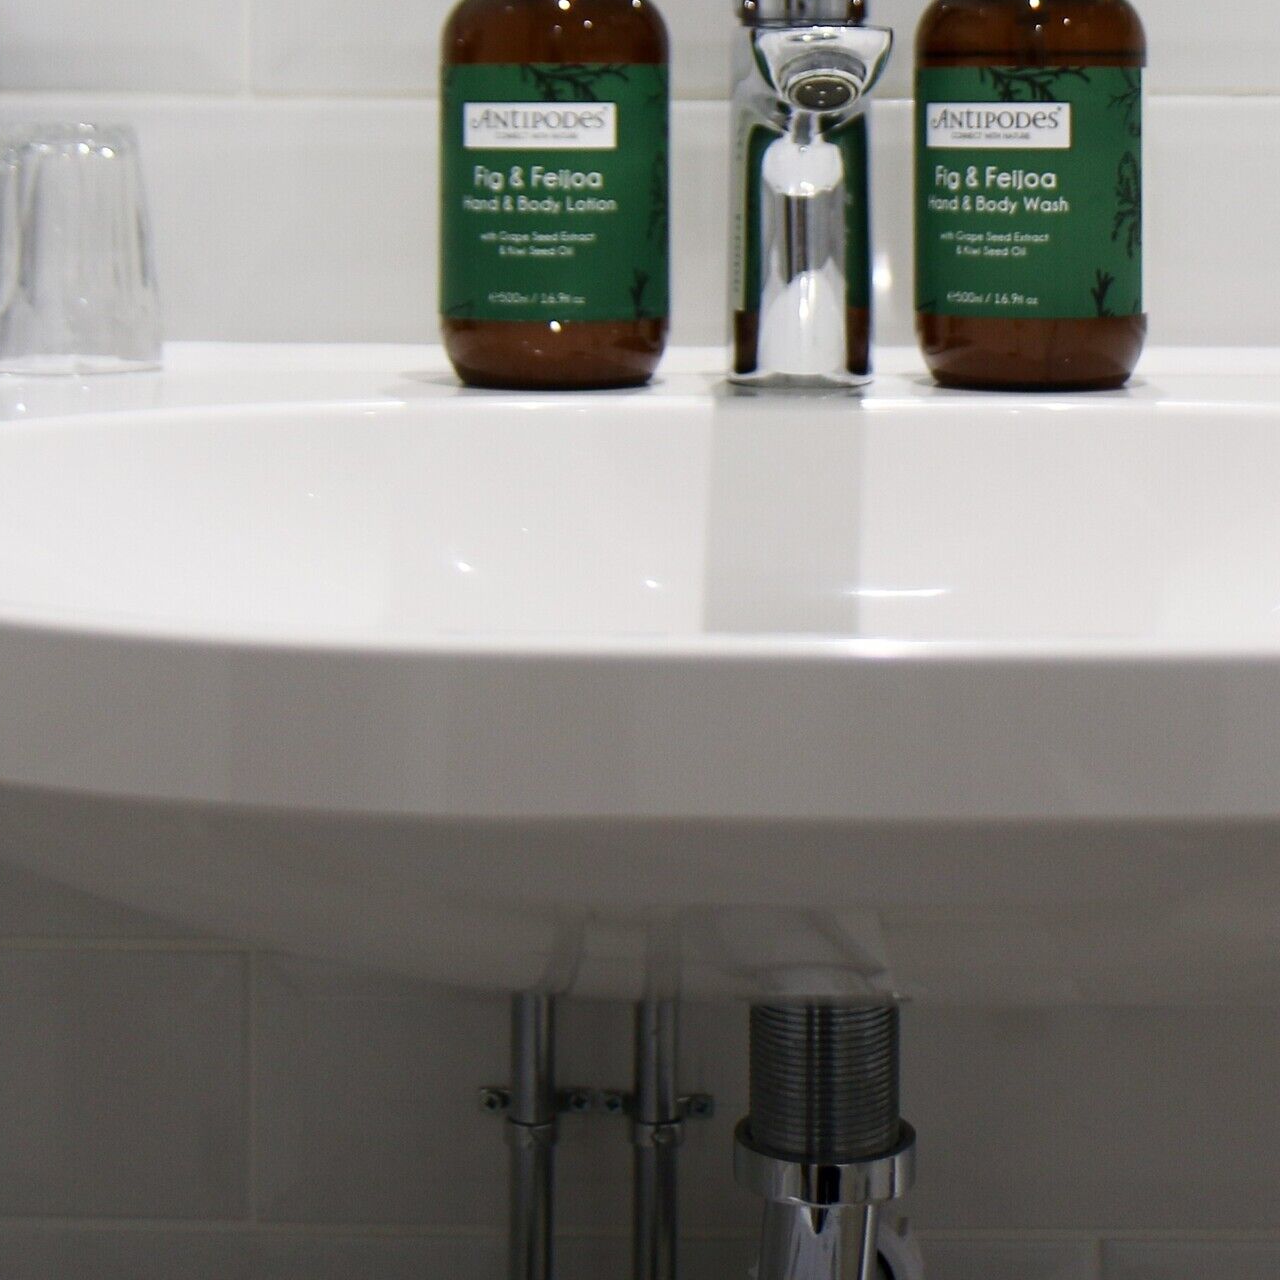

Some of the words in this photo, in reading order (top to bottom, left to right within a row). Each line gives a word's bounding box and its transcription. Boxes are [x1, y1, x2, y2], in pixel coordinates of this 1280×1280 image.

[473, 164, 505, 193] Fig
[508, 165, 526, 190] &
[530, 165, 604, 191] Feijoa
[934, 164, 961, 192] Fig
[964, 165, 979, 190] &
[984, 165, 1057, 191] Feijoa
[463, 195, 500, 212] Hand
[502, 195, 515, 212] &
[517, 195, 562, 215] Body
[565, 195, 618, 212] Lotion
[928, 195, 959, 212] Hand
[961, 195, 973, 212] &
[975, 195, 1018, 216] Body
[1023, 195, 1070, 212] Wash
[498, 230, 530, 244] Grape
[531, 231, 558, 242] Seed
[559, 231, 597, 242] Extract
[955, 230, 984, 244] Grape
[985, 231, 1012, 242] Seed
[1013, 231, 1050, 242] Extract
[528, 245, 556, 257] Seed
[982, 245, 1009, 257] Seed
[1010, 245, 1027, 257] Oil
